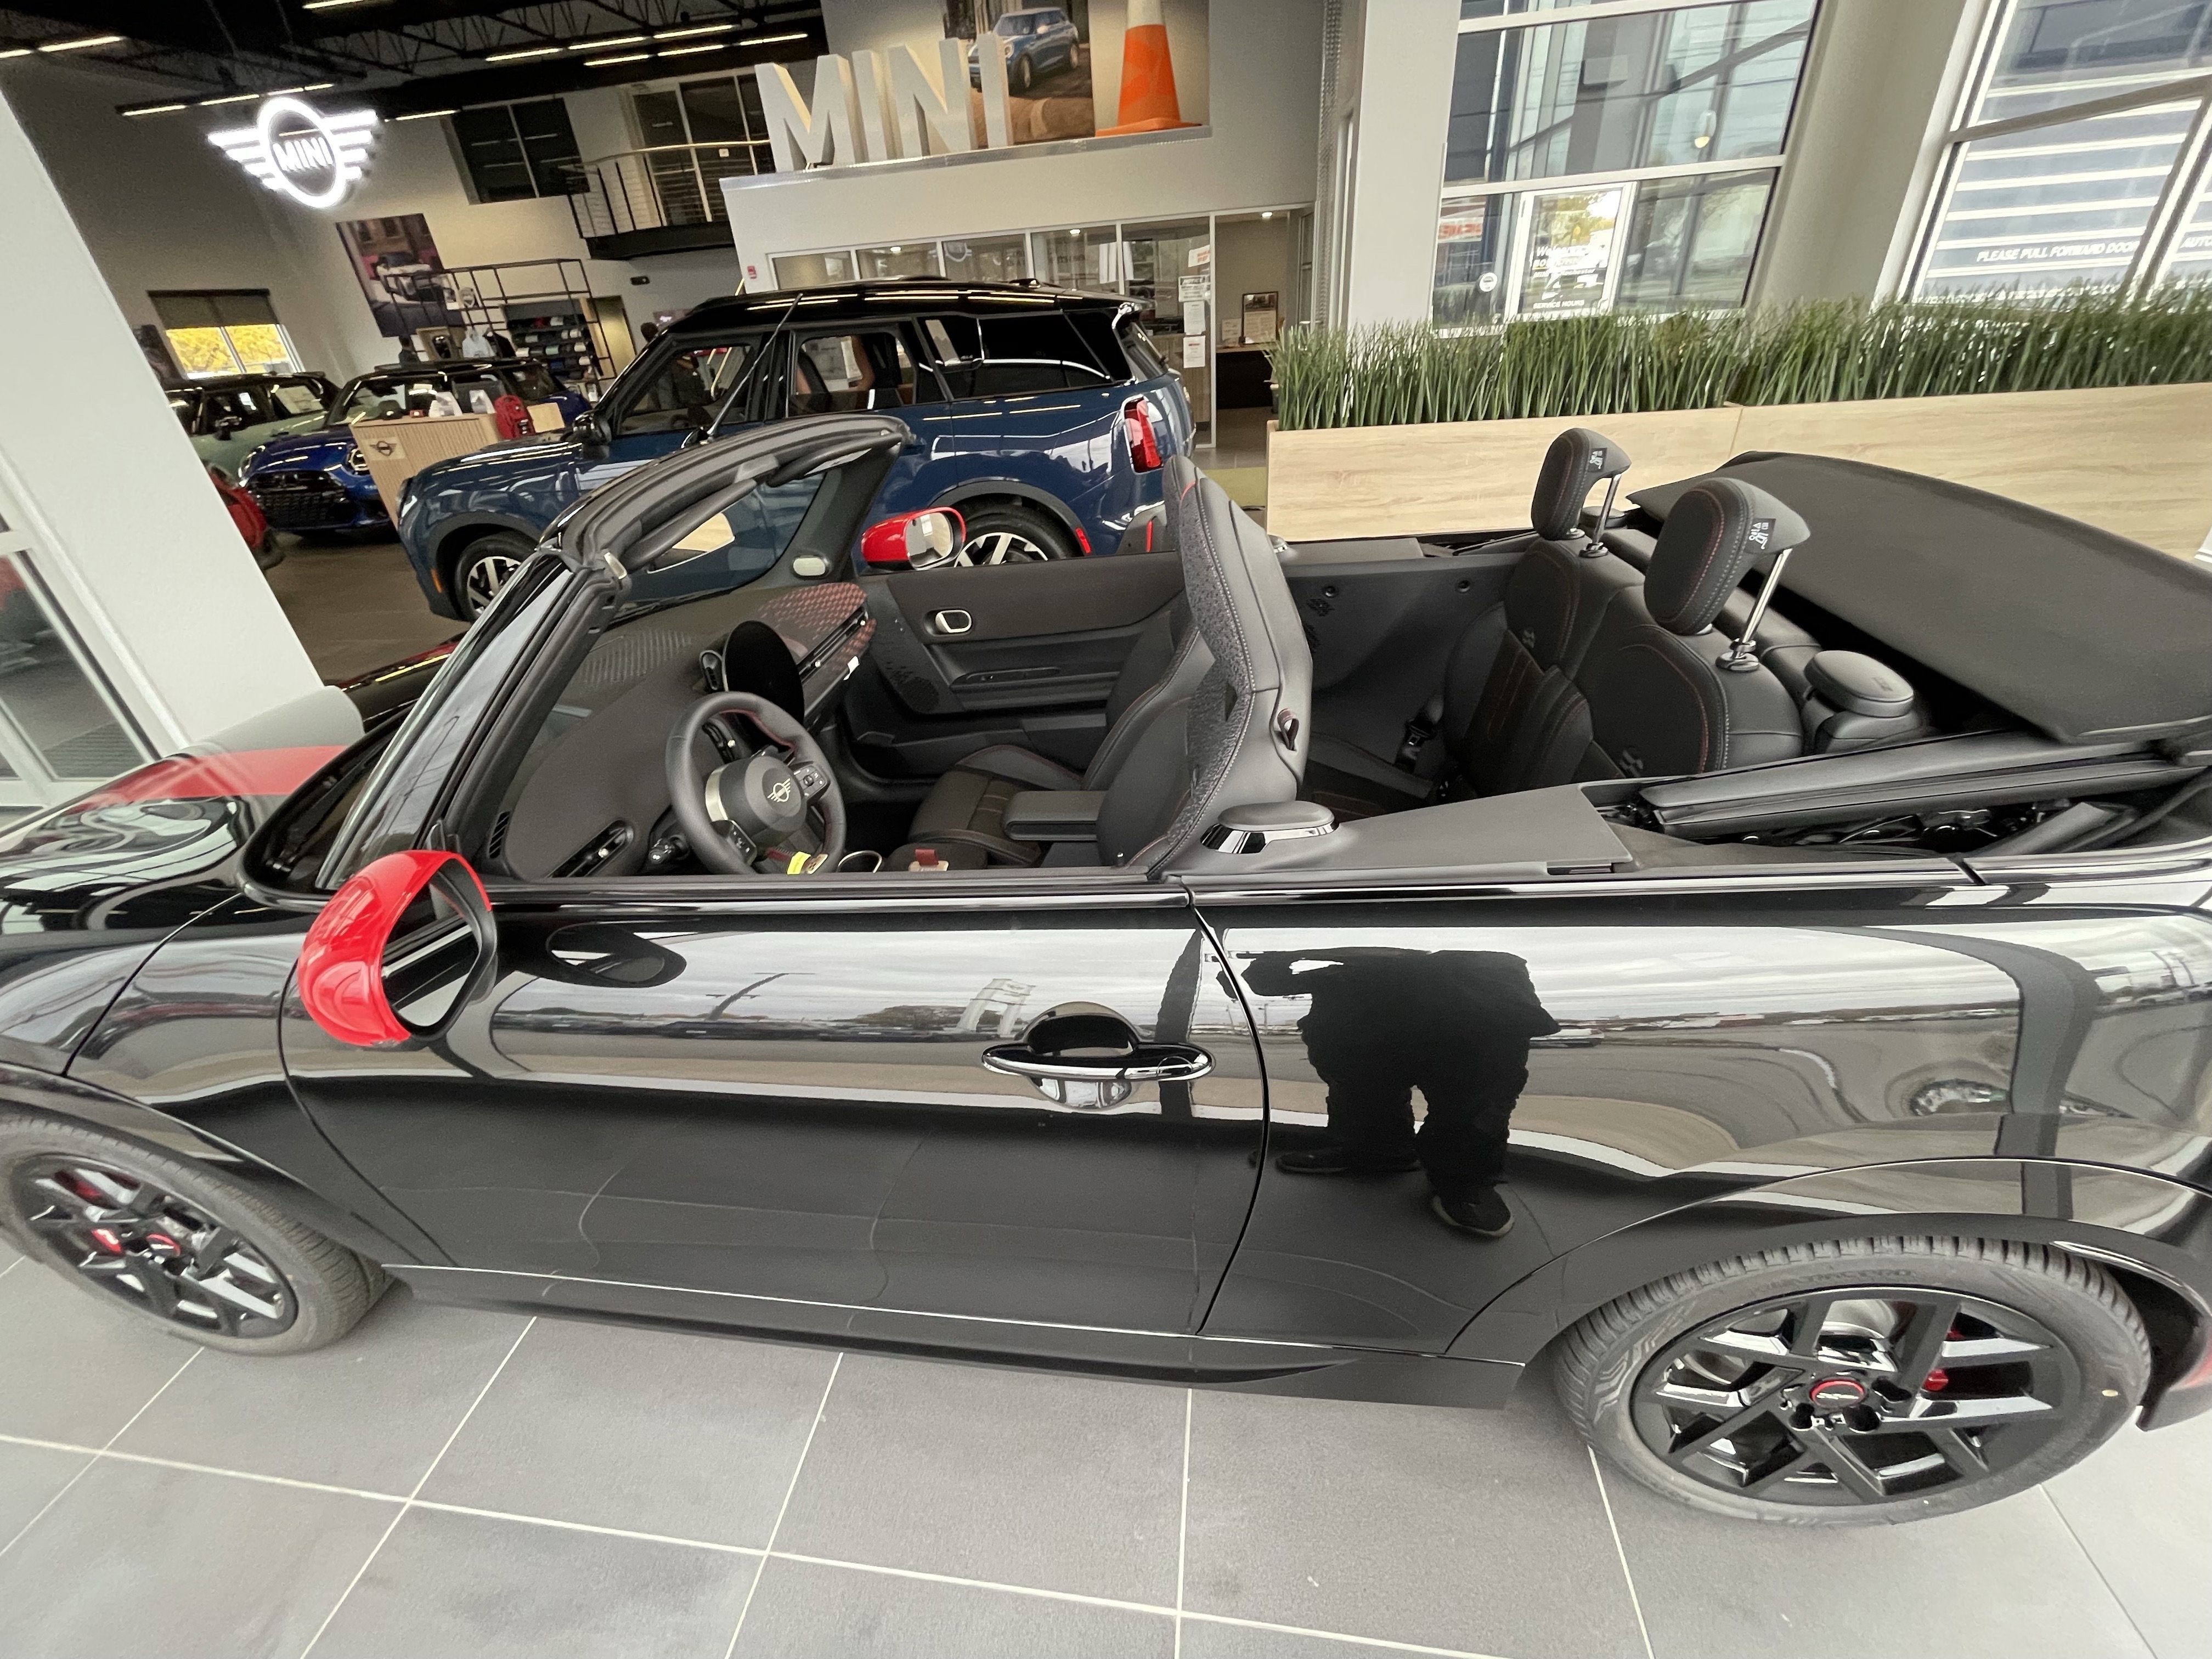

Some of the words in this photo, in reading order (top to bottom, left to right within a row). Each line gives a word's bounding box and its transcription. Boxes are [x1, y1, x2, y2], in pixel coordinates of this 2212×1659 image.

[755, 34, 1014, 172] MINI
[273, 137, 333, 171] MINI
[1977, 249, 2019, 262] PLEASE
[2020, 247, 2048, 259] PULL
[2050, 242, 2106, 257] FORWARD
